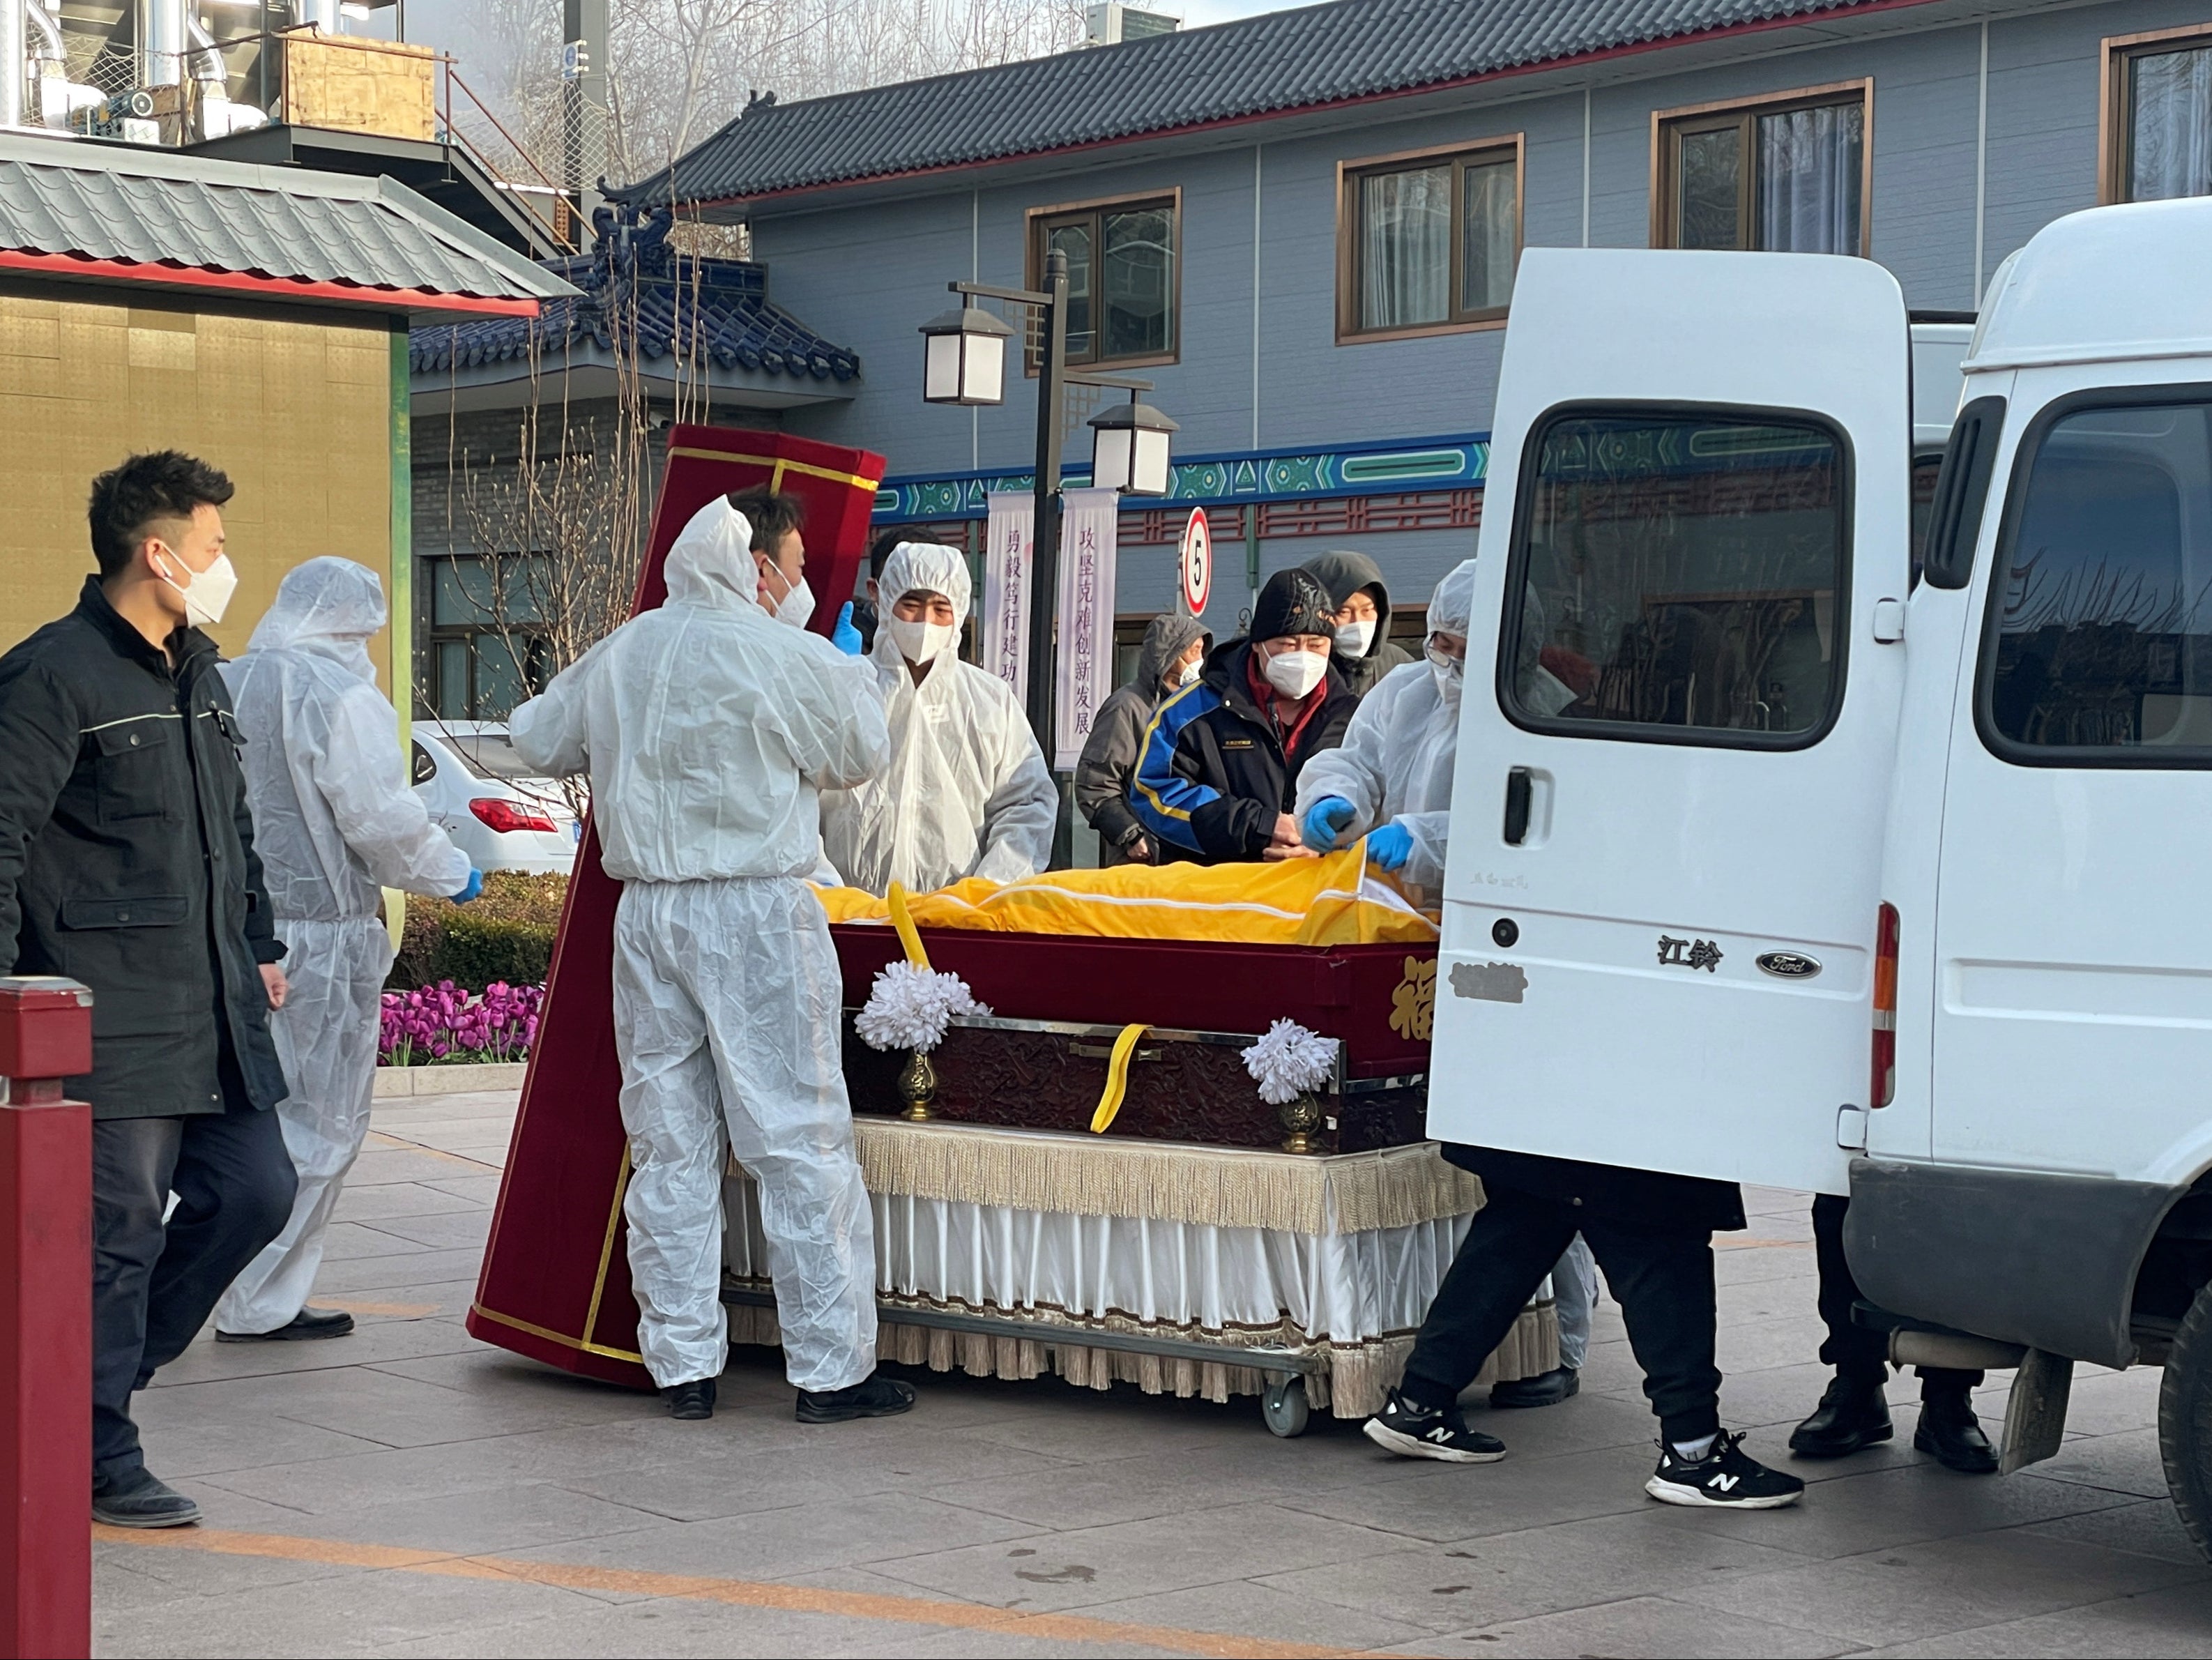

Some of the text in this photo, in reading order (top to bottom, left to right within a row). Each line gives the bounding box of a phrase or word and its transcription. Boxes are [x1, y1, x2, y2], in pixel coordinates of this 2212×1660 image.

[1193, 539, 1202, 587] 5
[1000, 530, 1021, 682] 勇毅笃行建功
[1075, 527, 1095, 735] 攻坚克难创新发展
[1658, 935, 1724, 973] 江铃
[1769, 954, 1806, 973] Ford
